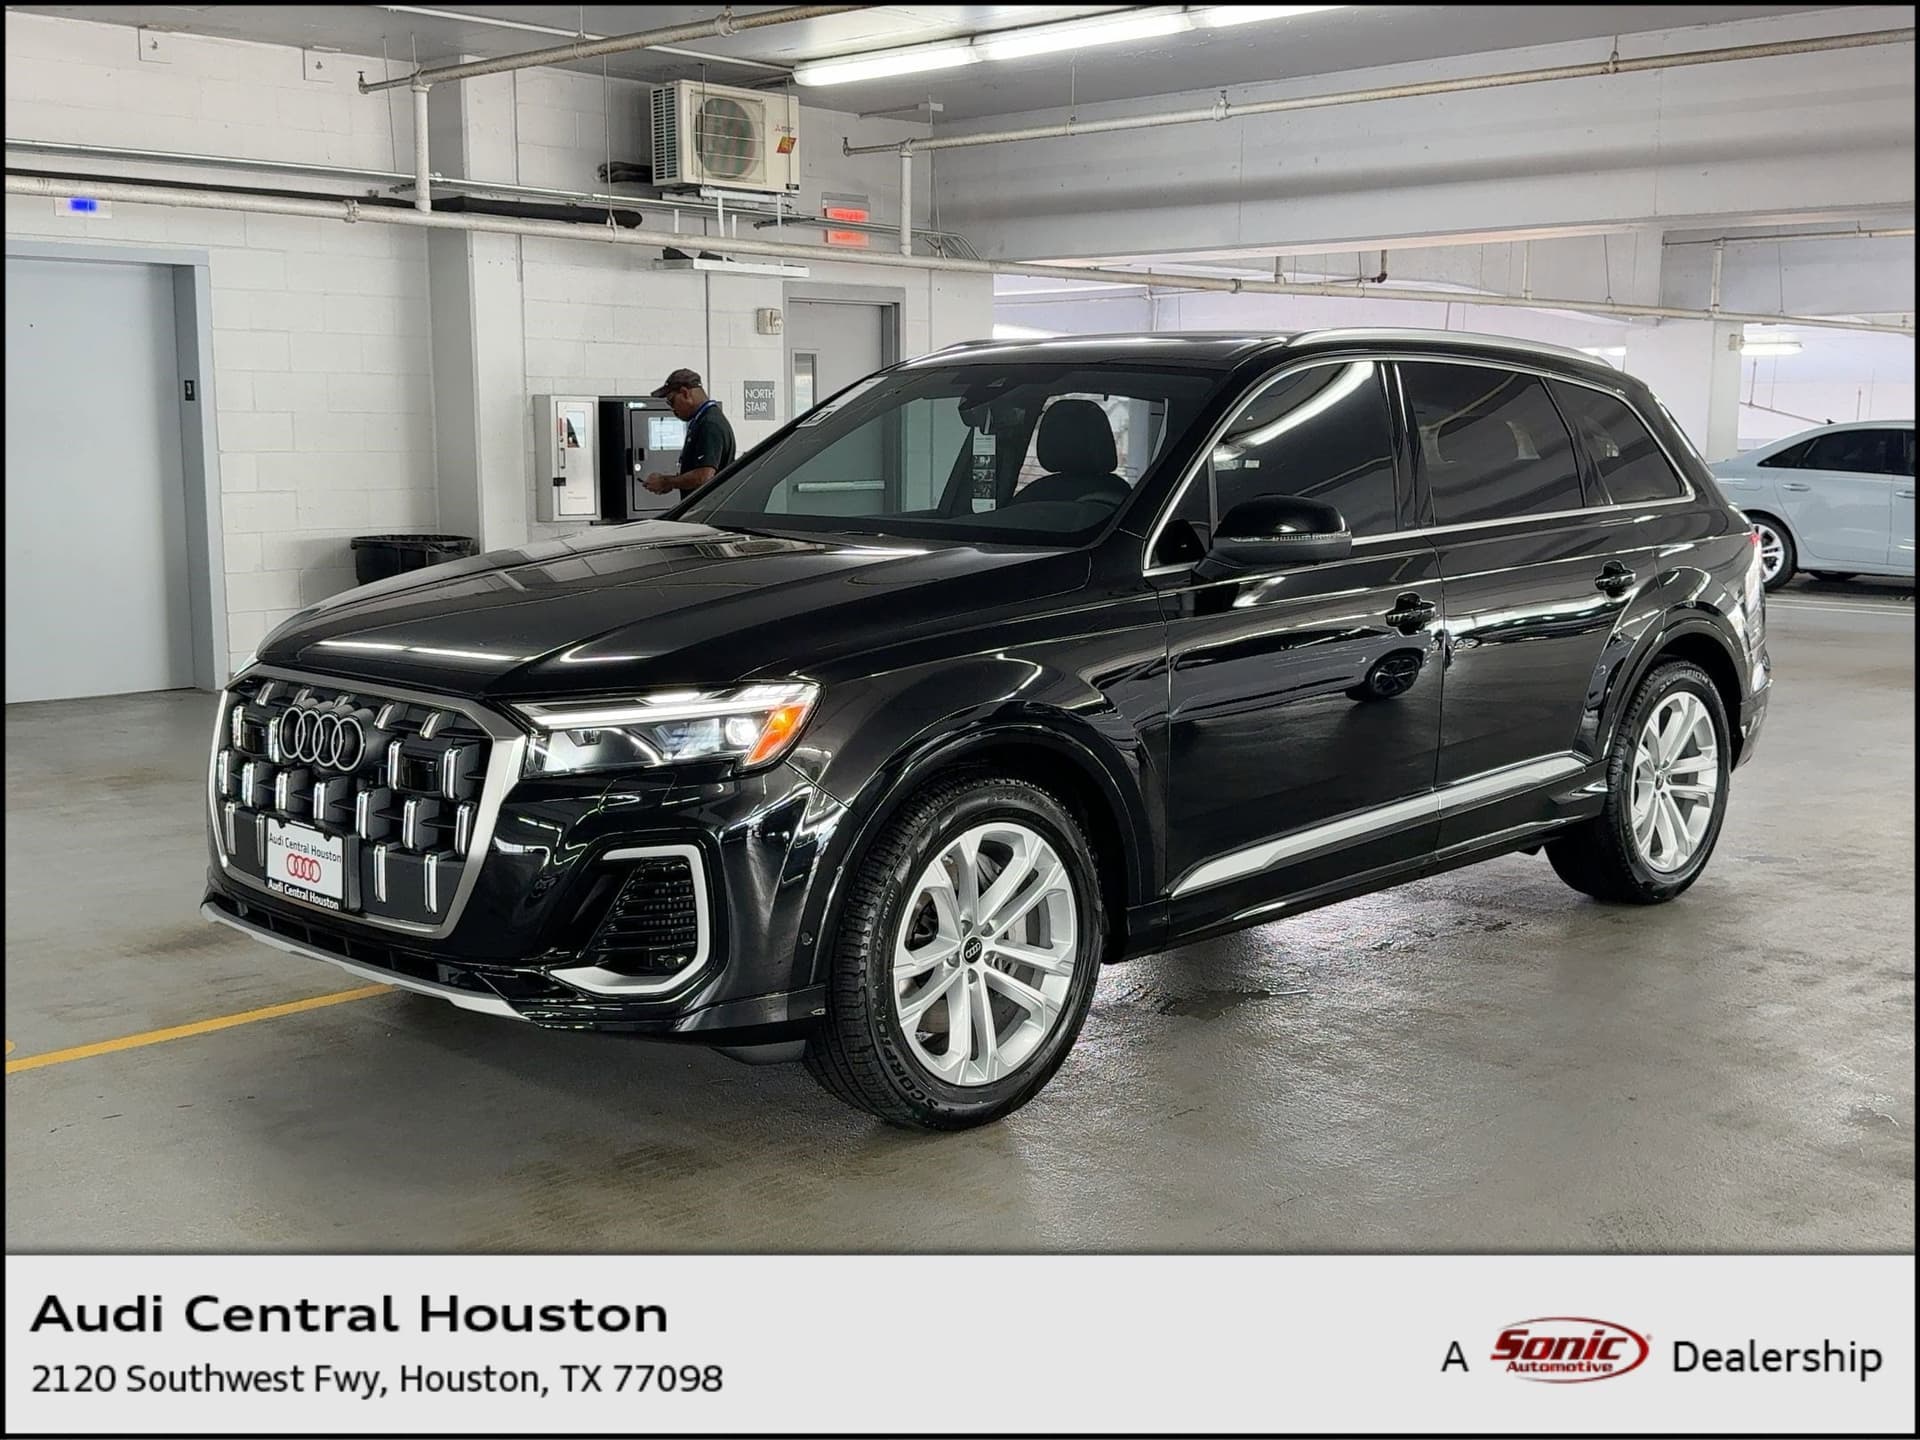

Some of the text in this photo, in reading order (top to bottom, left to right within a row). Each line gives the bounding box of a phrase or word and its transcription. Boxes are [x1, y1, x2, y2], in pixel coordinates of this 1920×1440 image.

[745, 389, 775, 399] NORTH
[745, 401, 768, 412] STAIR
[269, 832, 342, 864] Audi Central Houston
[268, 880, 340, 910] Audi Central Houston
